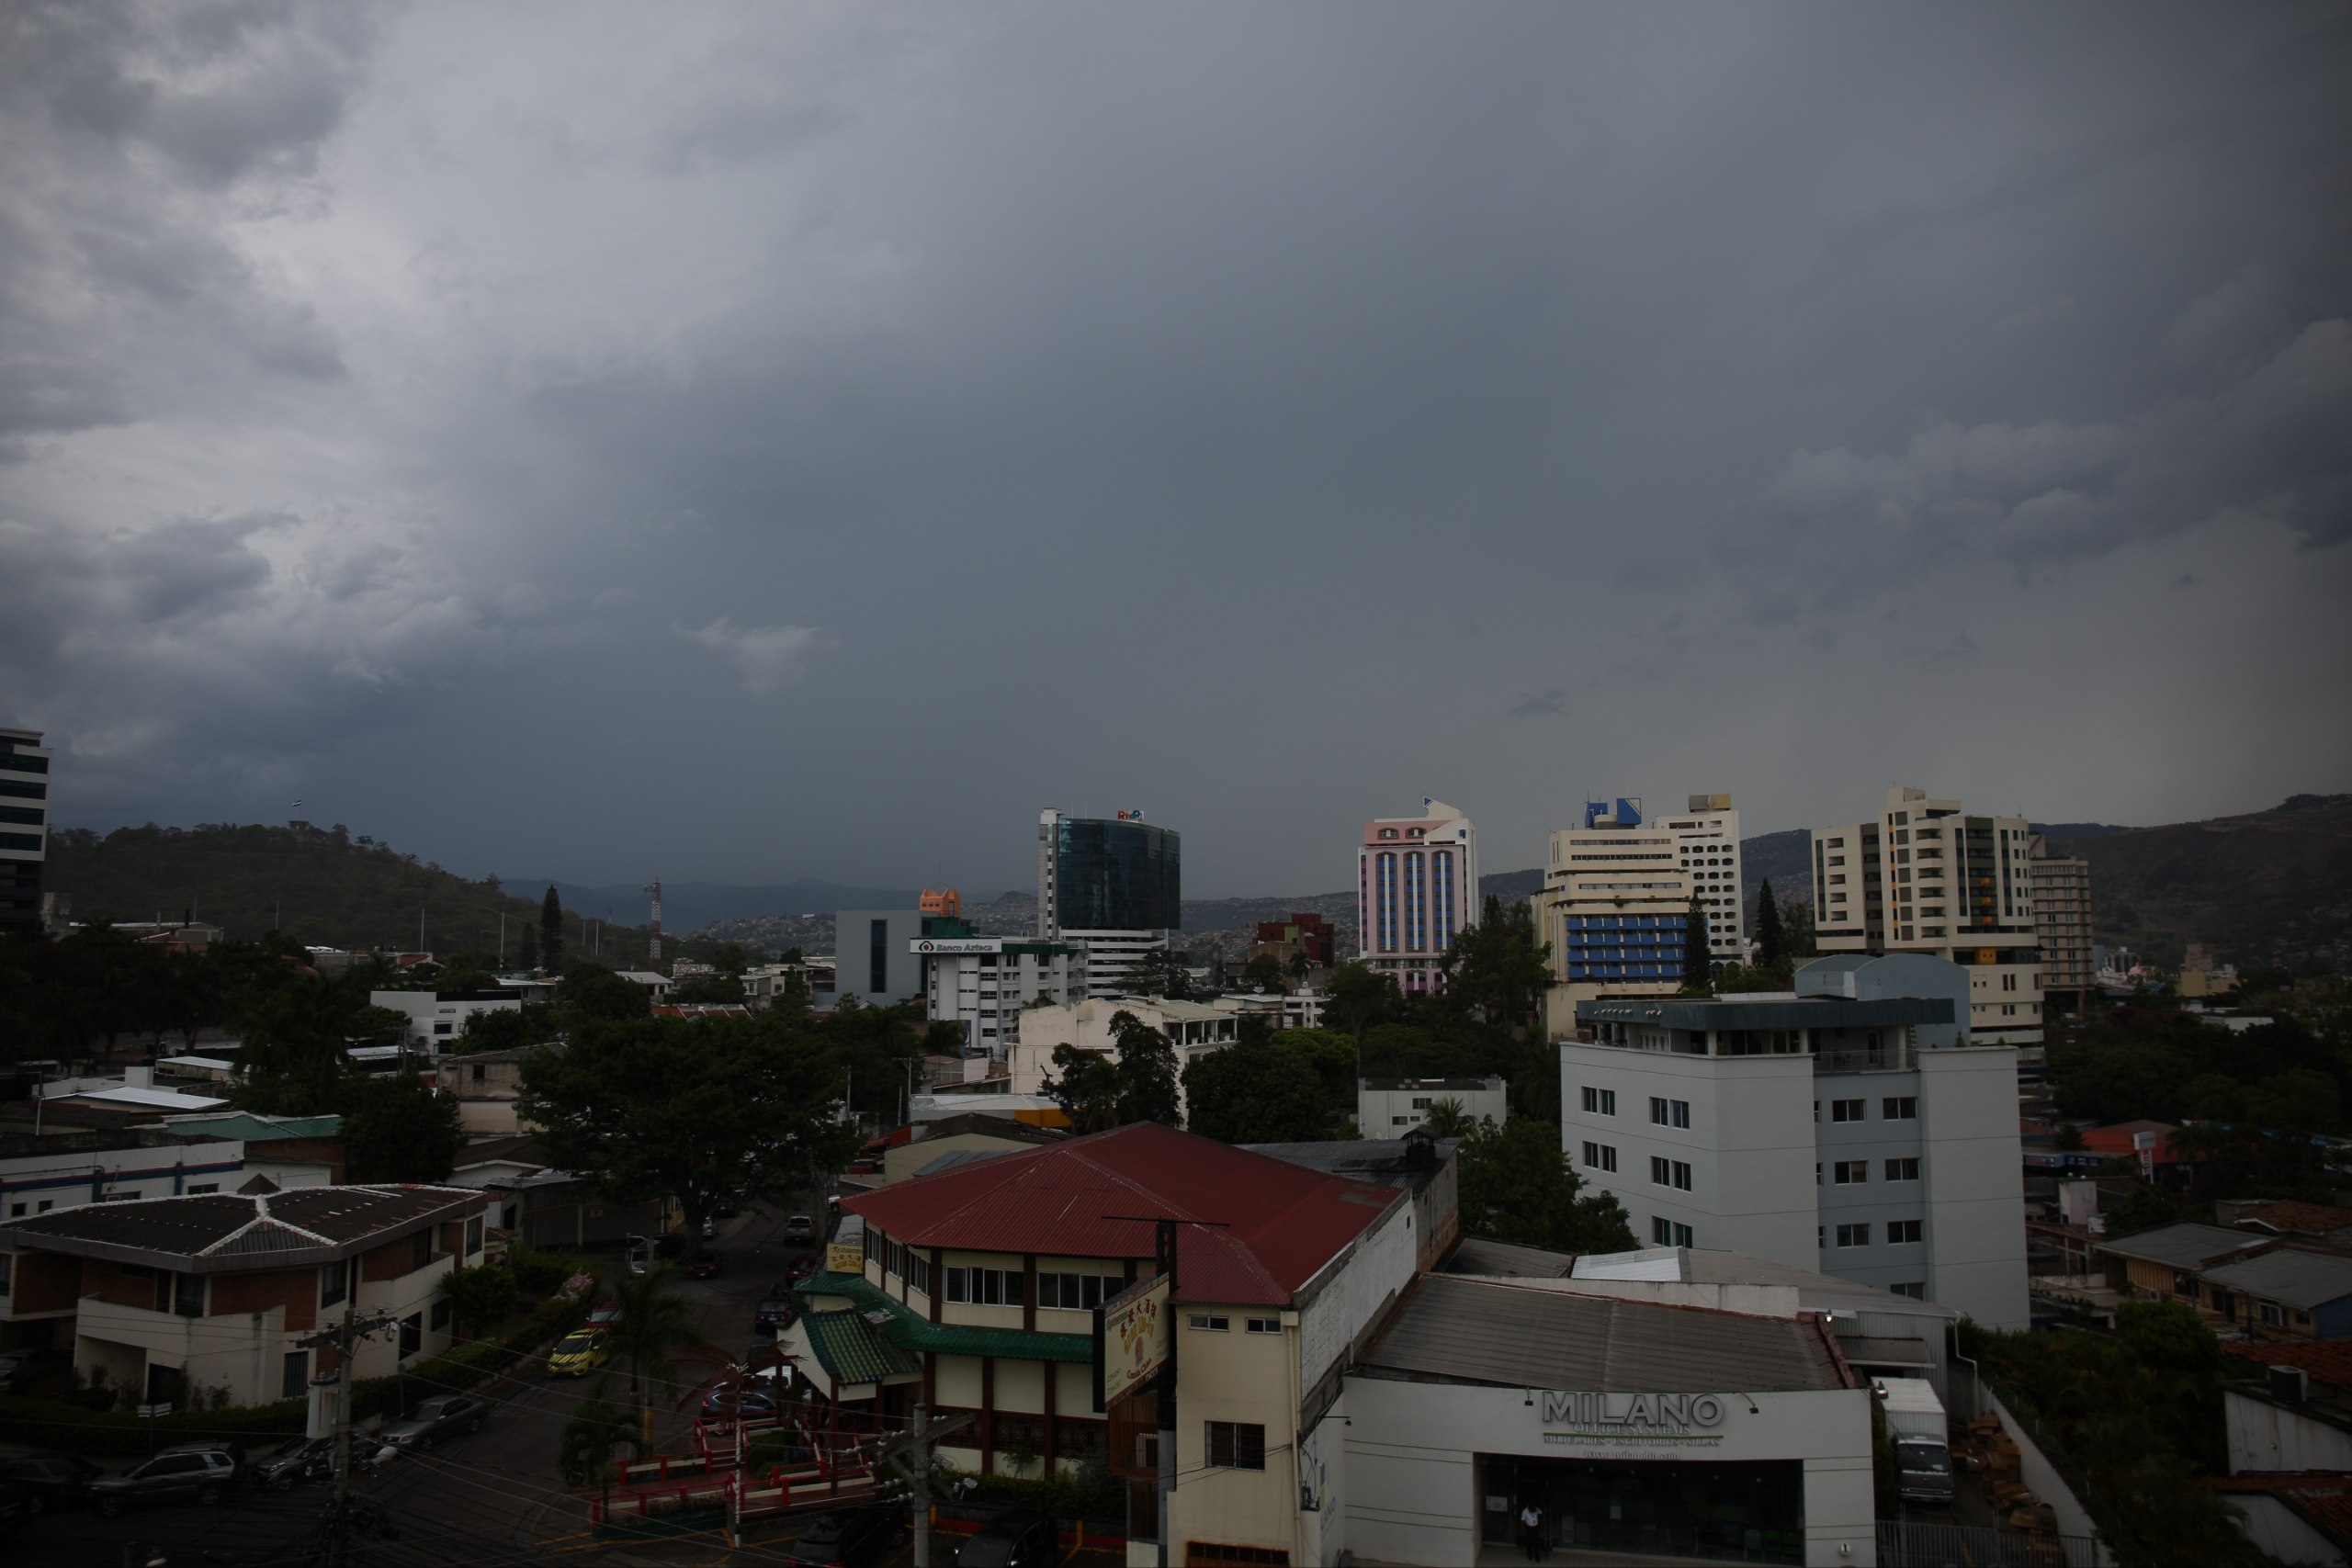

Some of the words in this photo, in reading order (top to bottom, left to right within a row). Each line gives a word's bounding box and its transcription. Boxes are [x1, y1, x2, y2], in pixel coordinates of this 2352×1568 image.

[936, 943, 962, 952] Banco
[964, 943, 993, 952] Azteca
[1543, 1392, 1724, 1427] MILANO
[1574, 1424, 1621, 1435] OFFICE
[1629, 1425, 1691, 1435] SYSTEMS
[1543, 1436, 1606, 1446] MODULARES
[1612, 1437, 1679, 1447] ESCRITORIOS
[1686, 1437, 1721, 1447] SILLAS
